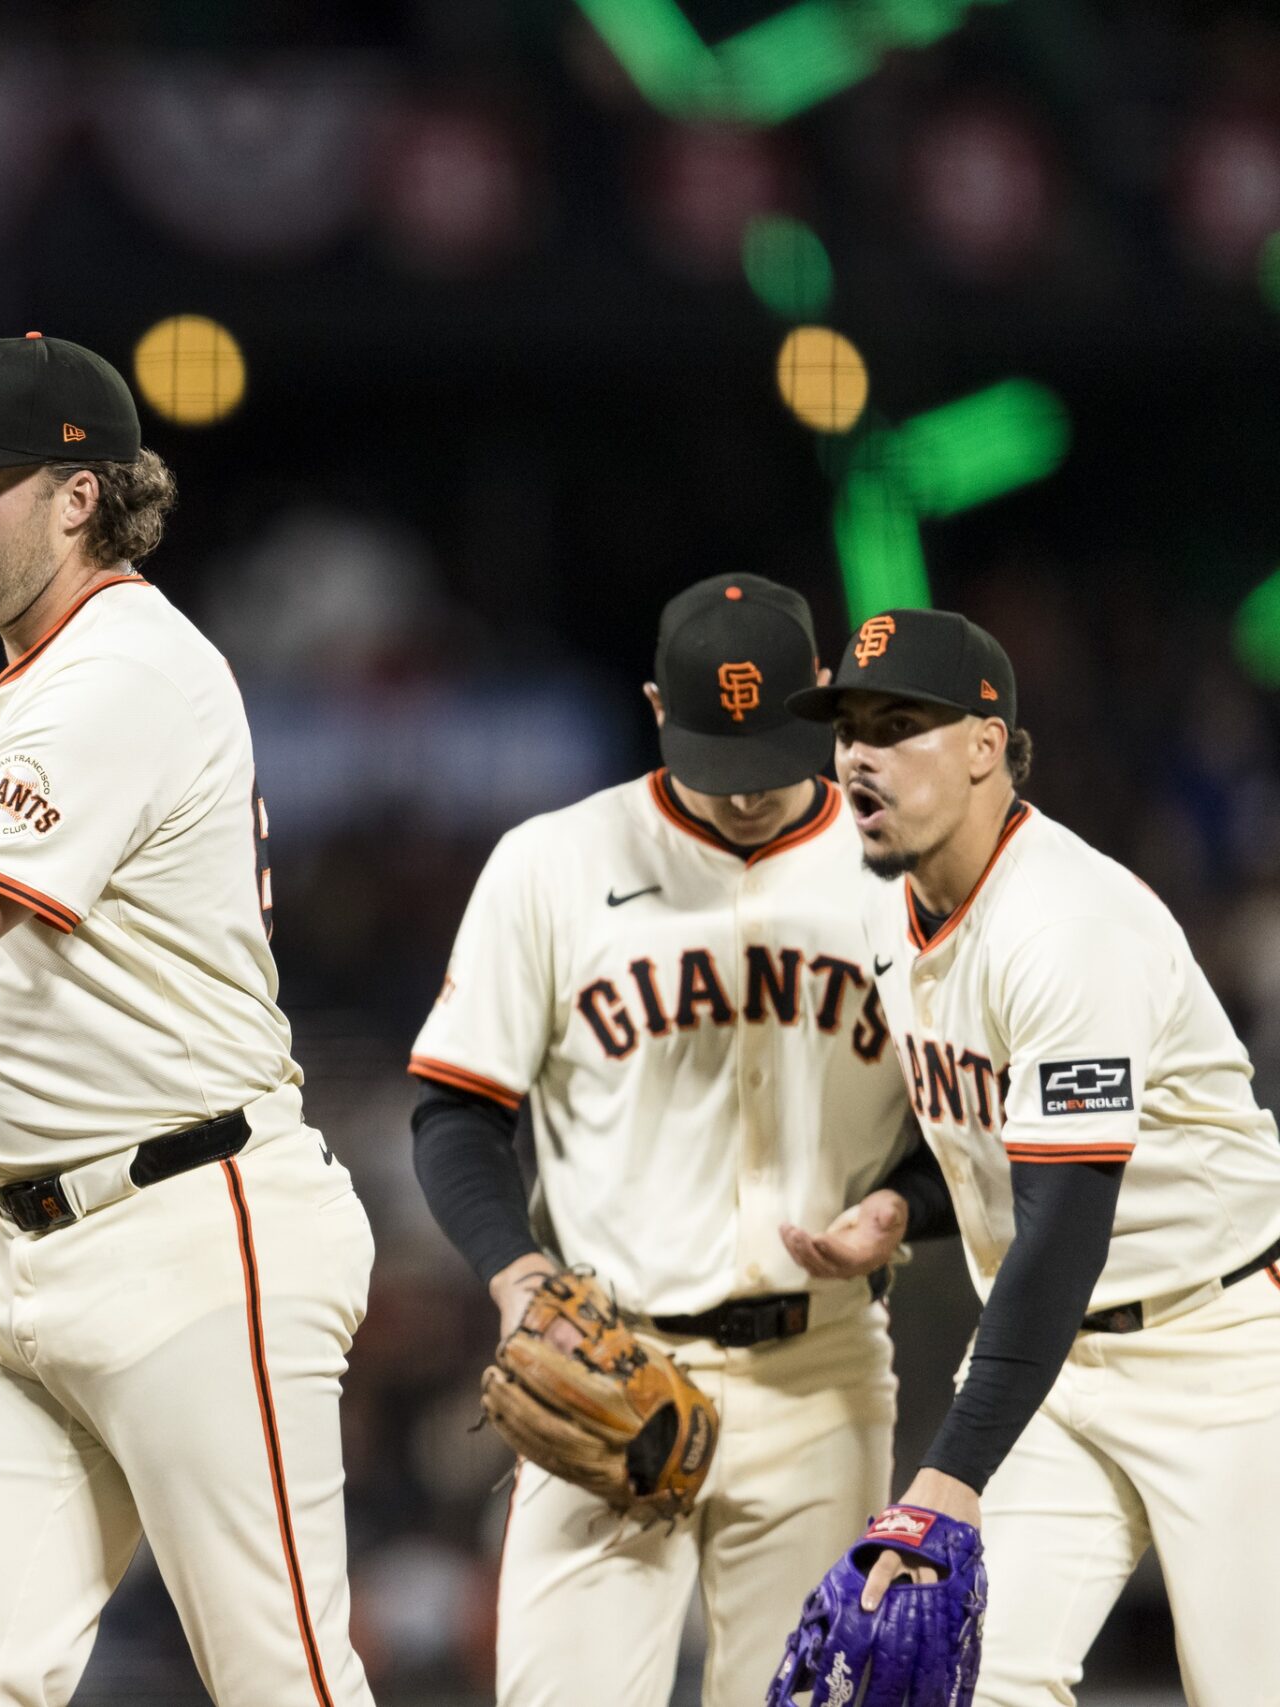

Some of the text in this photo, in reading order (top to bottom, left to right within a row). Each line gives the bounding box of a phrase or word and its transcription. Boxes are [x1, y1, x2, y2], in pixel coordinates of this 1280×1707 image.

[718, 661, 762, 721] SF
[14, 754, 51, 796] FRANCISCO
[3, 823, 27, 834] CLUB
[576, 944, 891, 1066] GIANTS
[1046, 1096, 1128, 1112] CHEVROLET
